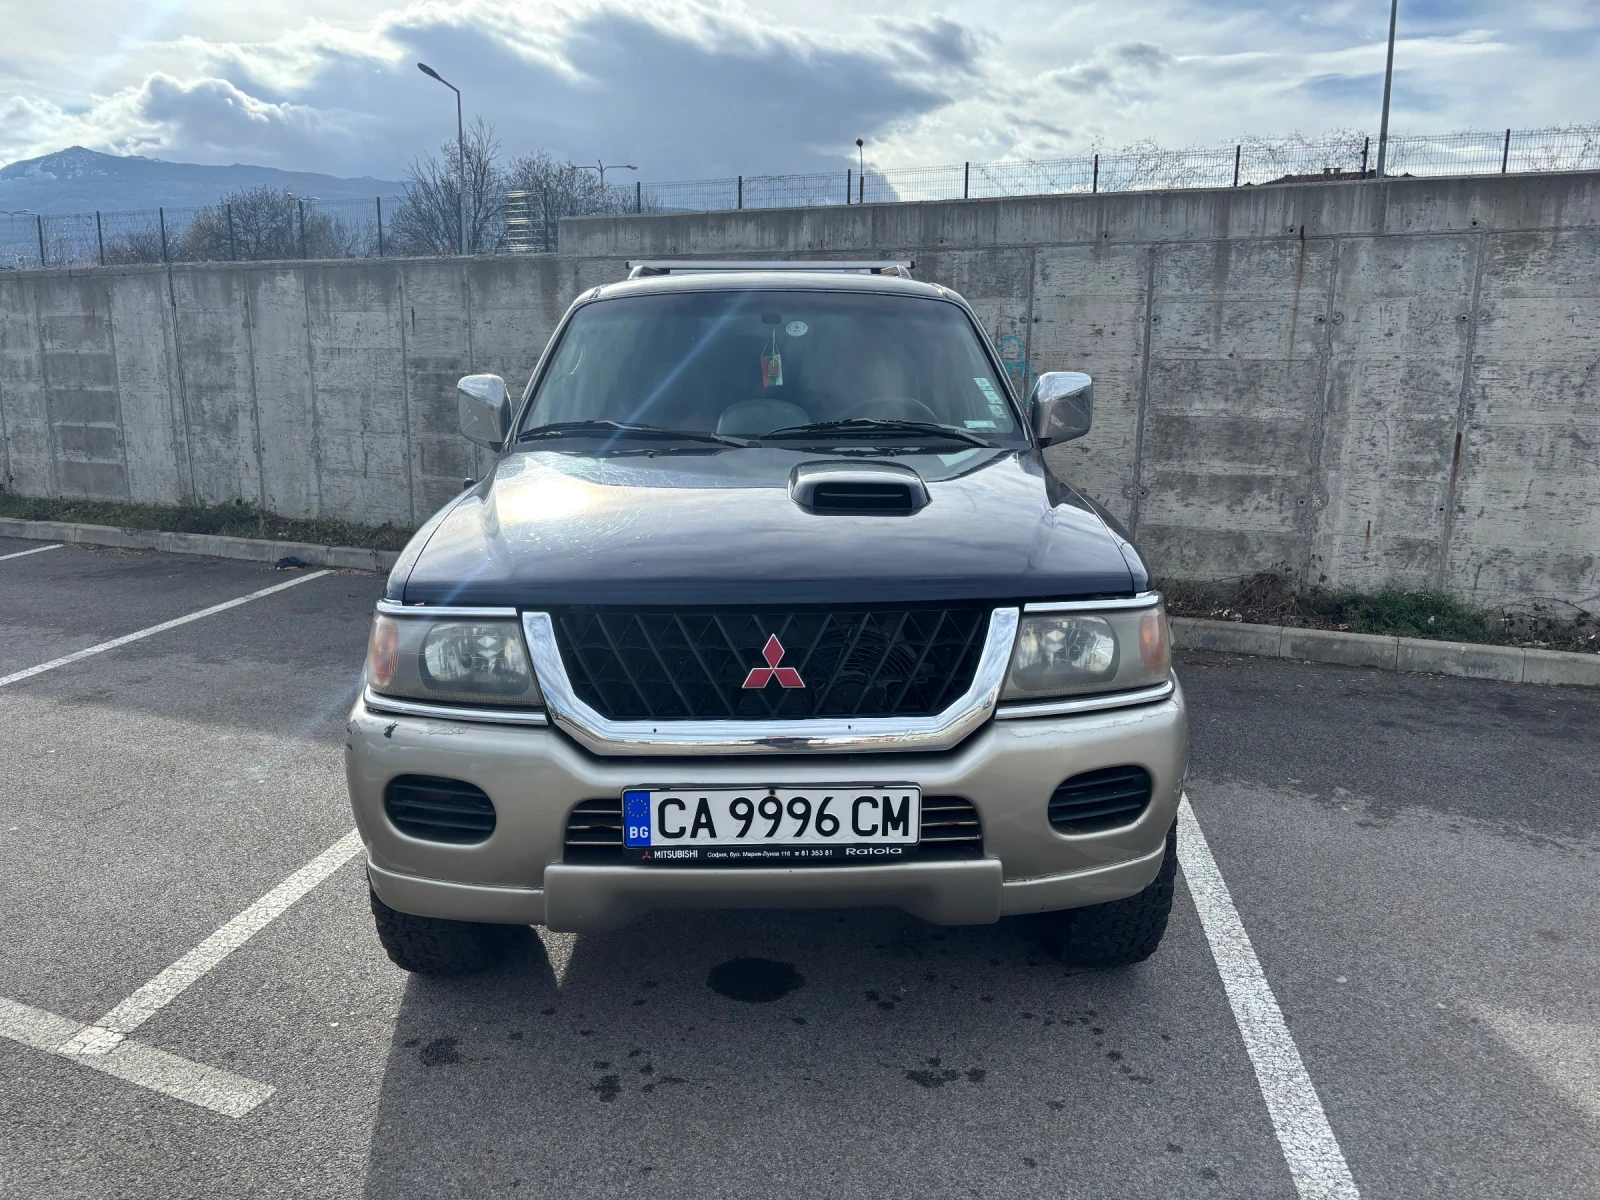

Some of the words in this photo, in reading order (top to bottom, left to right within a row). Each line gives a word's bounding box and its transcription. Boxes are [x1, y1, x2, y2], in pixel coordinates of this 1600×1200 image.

[658, 797, 717, 839] CA
[729, 796, 840, 838] 9996
[851, 795, 910, 837] CM
[629, 826, 649, 839] BG
[654, 849, 698, 859] MITSUBISHI
[846, 847, 902, 856] Ratola
